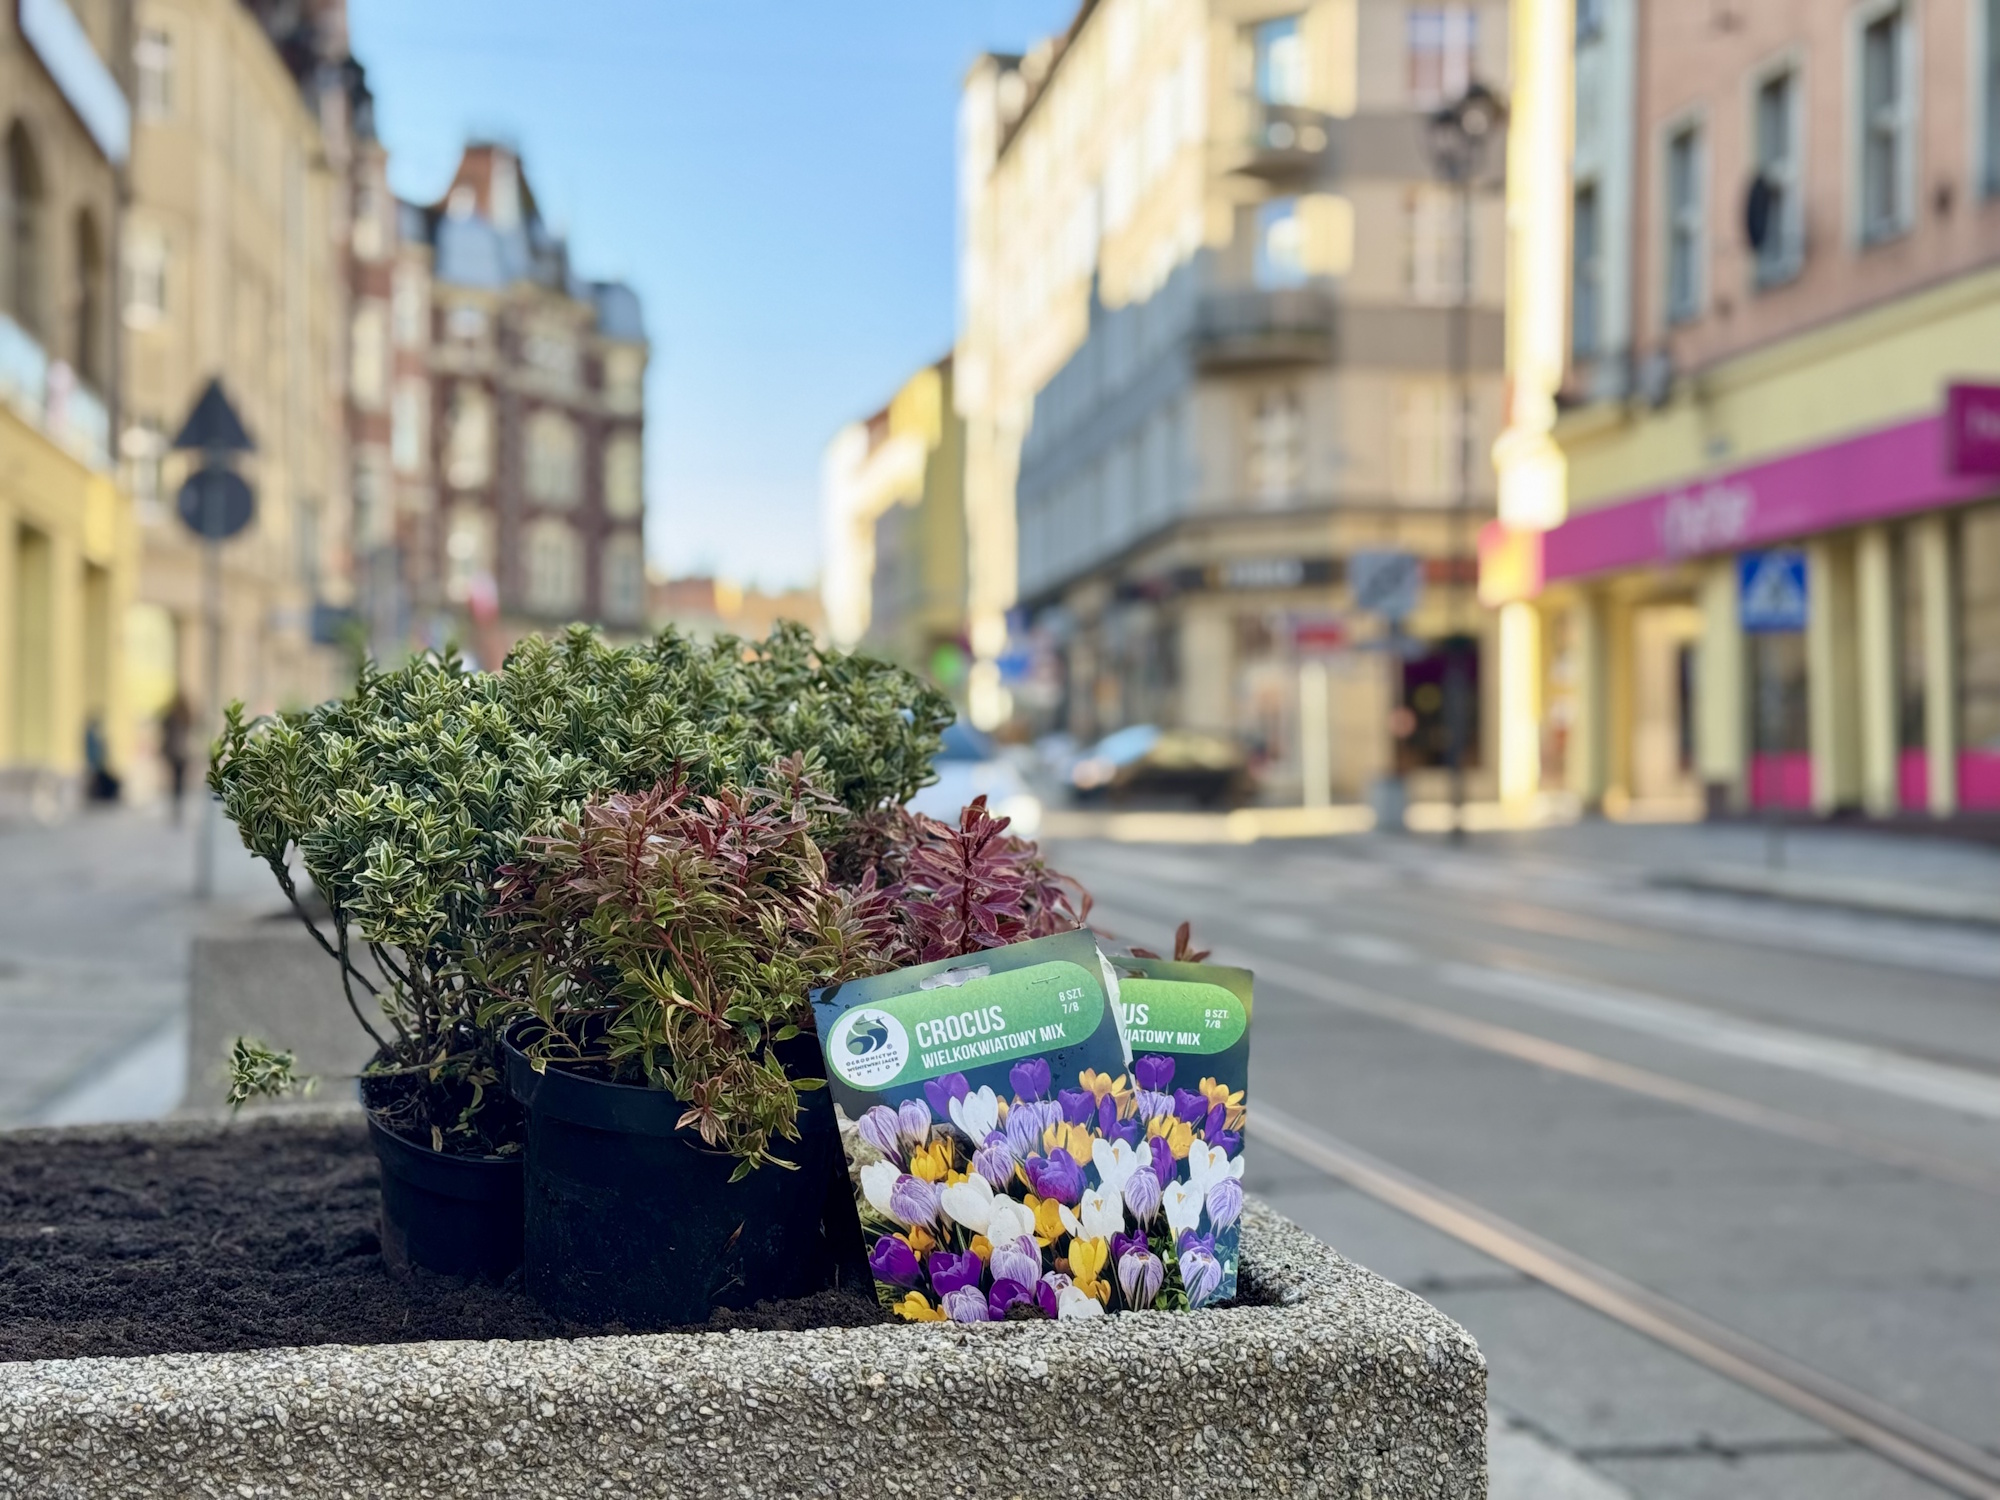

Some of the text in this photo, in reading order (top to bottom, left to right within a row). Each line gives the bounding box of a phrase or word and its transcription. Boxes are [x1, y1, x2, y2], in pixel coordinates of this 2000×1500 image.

[1058, 991, 1066, 1002] 8
[1061, 1001, 1080, 1015] 7/8
[914, 1005, 1006, 1049] CROCUS
[1204, 1019, 1221, 1029] 7/8
[921, 1022, 1066, 1069] WIELKOKWIATOWY MIX
[1176, 1031, 1200, 1046] MIX
